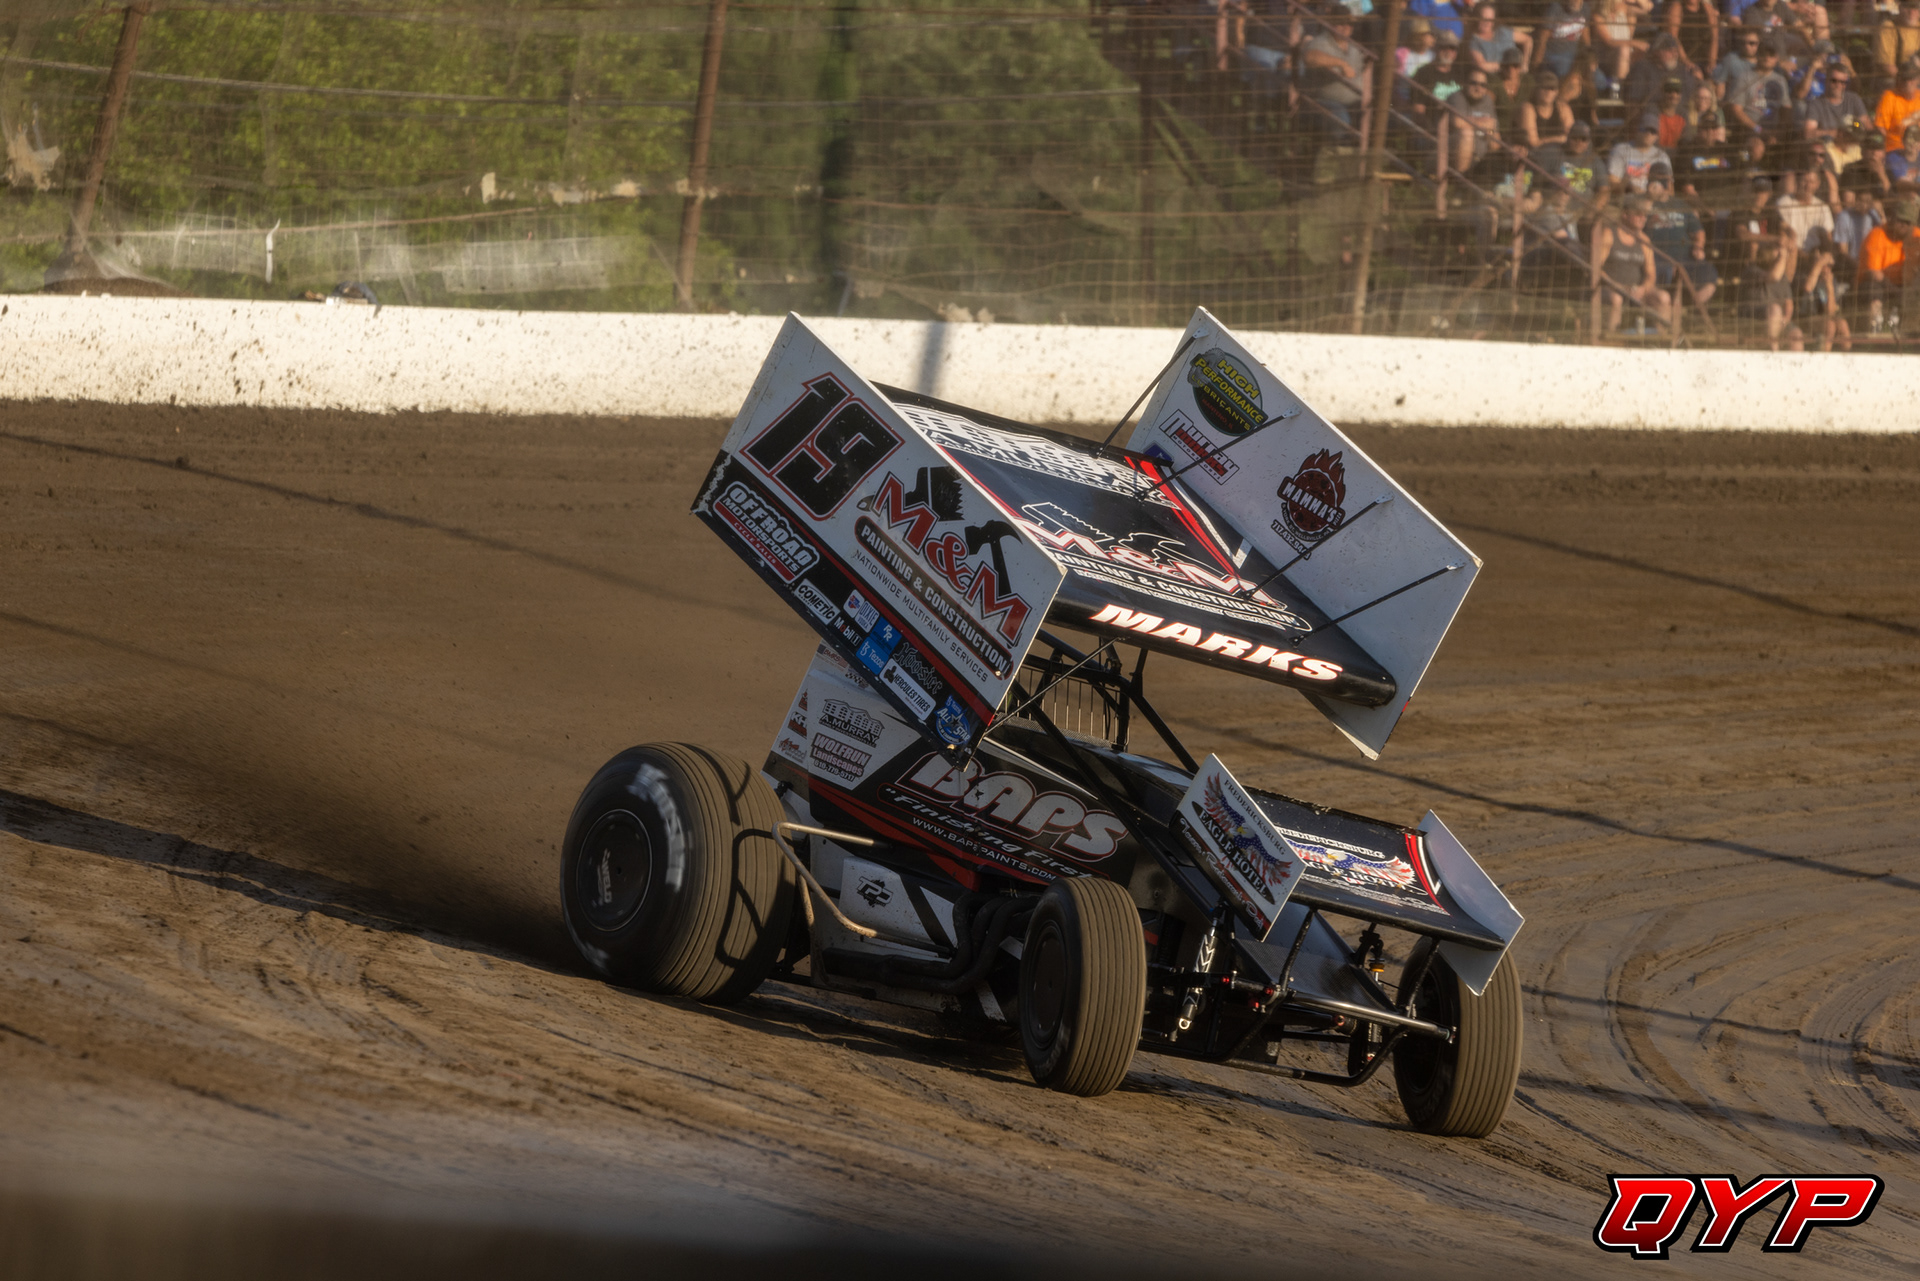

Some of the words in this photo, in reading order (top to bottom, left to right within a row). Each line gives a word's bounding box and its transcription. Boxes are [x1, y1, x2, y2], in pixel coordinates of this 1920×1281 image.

[1192, 374, 1251, 431] LUBRICANTS
[1194, 358, 1264, 423] PERFORMANCE
[1217, 359, 1260, 400] HIGH
[1172, 435, 1221, 480] MOTORSORTS
[730, 488, 812, 566] OFFROAD
[1282, 482, 1338, 523] MAMMA'S
[722, 497, 800, 572] MOTORSPORTS
[733, 522, 755, 543] CYCLE
[755, 543, 777, 564] SALES
[870, 471, 1032, 645] M&M
[798, 585, 835, 619] COMETIC
[855, 549, 902, 597] NATIONWIDE
[902, 595, 950, 644] MULTIFAMILY
[949, 642, 988, 682] SERVICES
[860, 602, 878, 626] DIXIE
[861, 524, 912, 582] PAINTING
[913, 577, 923, 591] &
[924, 583, 1011, 673] CONSTRUCTION
[1051, 552, 1132, 585] AINTING
[1137, 575, 1156, 587] &
[1155, 581, 1299, 626] CONSTRUCTION
[869, 649, 885, 668] Tezos
[893, 642, 943, 695] Hoosier
[1089, 603, 1343, 681] MARKS
[893, 673, 917, 699] HERCULES
[914, 691, 931, 713] TIRES
[812, 733, 871, 767] WOLFRUN
[820, 714, 880, 743] A.MURRAY
[812, 747, 863, 776] Landscapes
[894, 751, 1129, 862] BAPS
[1224, 779, 1286, 855] FREDERICKSBURG
[1199, 810, 1237, 854] EAGLE
[1232, 850, 1269, 898] HOTEL
